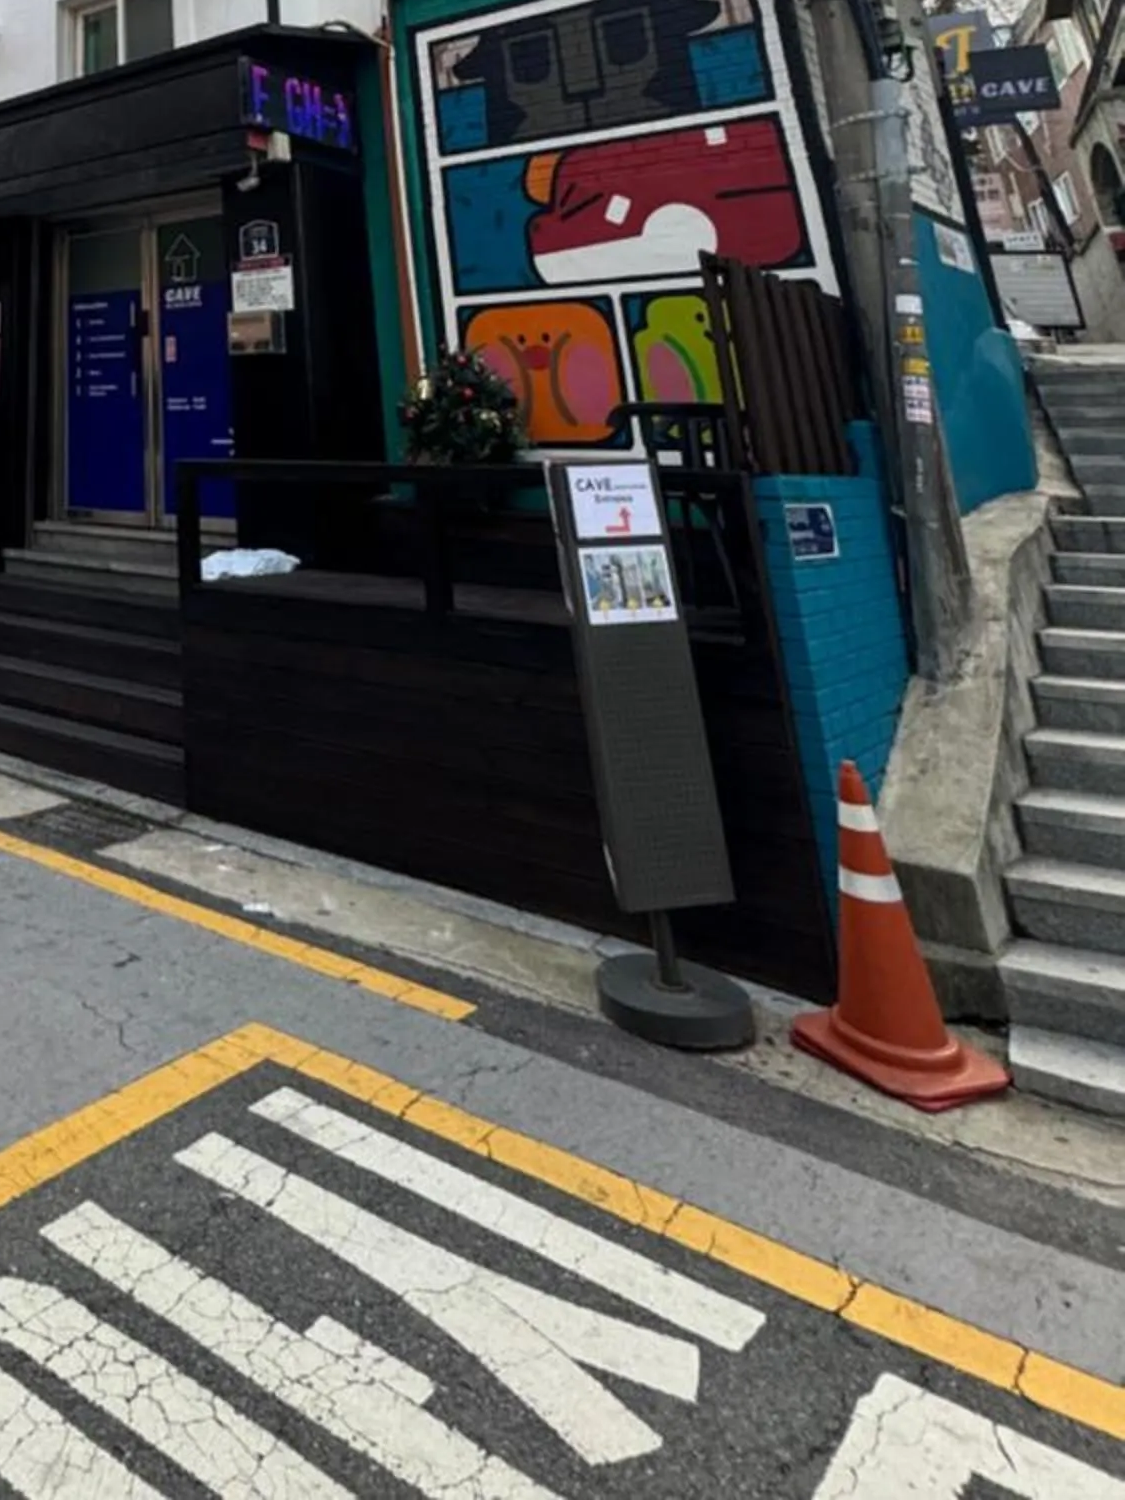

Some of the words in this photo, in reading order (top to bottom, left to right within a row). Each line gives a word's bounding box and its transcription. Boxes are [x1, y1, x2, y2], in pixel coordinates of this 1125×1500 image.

[981, 76, 1051, 98] CAVE
[165, 285, 202, 302] CAVE
[575, 477, 612, 493] CAVE
